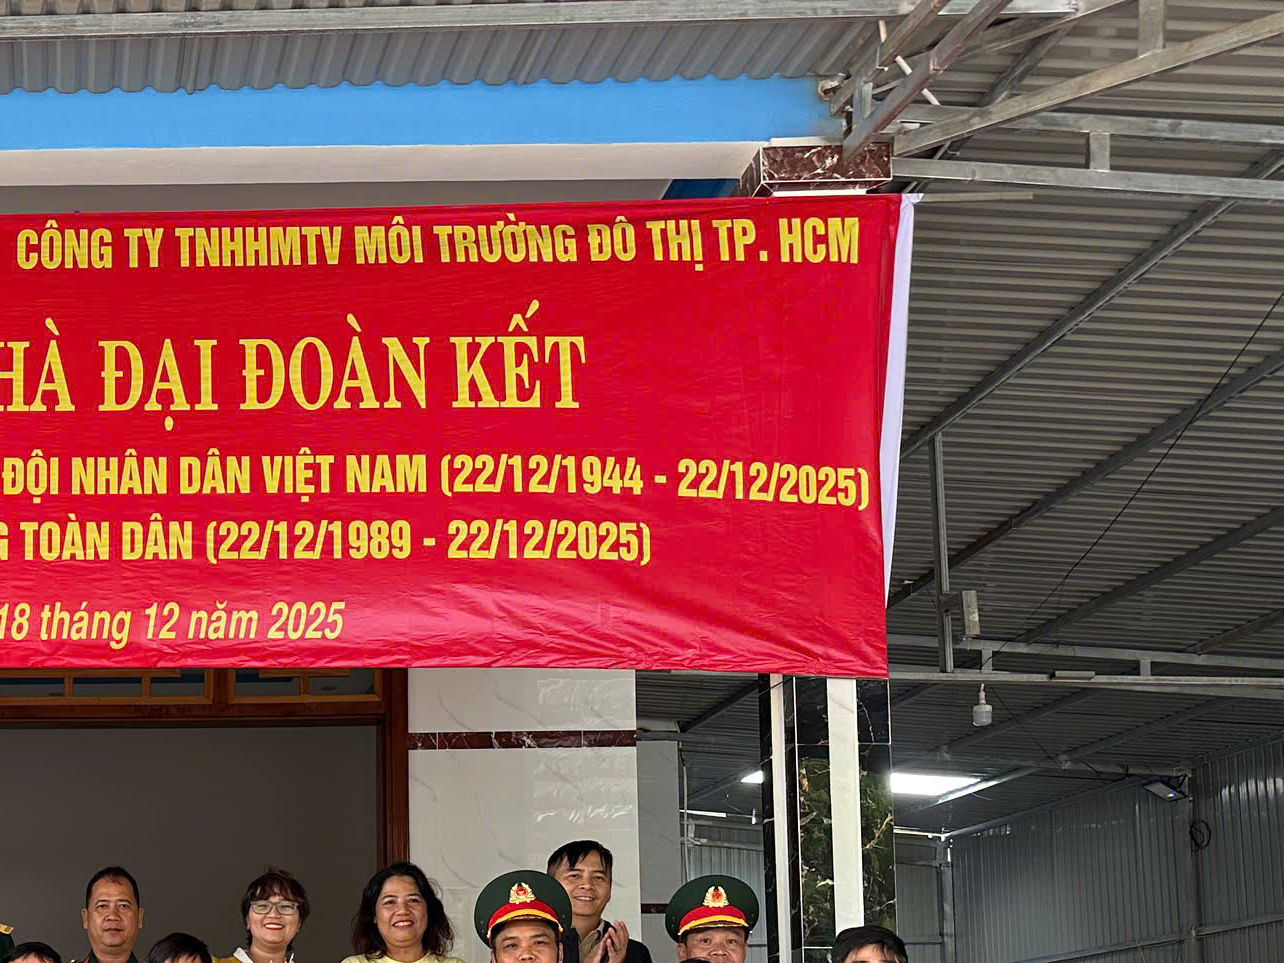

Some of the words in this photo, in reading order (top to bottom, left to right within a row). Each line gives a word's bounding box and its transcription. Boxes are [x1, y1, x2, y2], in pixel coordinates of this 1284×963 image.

[16, 219, 113, 270] CÔNG
[123, 227, 165, 268] TY
[174, 226, 342, 268] TNHHMTV
[355, 215, 424, 265] MÔI
[432, 212, 578, 263] TRƯỜNG
[587, 215, 637, 262] ĐÔ
[645, 219, 705, 272] THỊ
[712, 218, 768, 262] TP.
[779, 216, 860, 264] HCM
[98, 338, 219, 431] ĐẠI
[238, 313, 430, 411] ĐOÀN
[449, 299, 586, 409] KẾT
[1, 448, 59, 504] ĐỘI
[71, 448, 168, 495] NHÂN
[179, 448, 251, 495] DÂN
[261, 447, 335, 503] VIỆT
[345, 454, 427, 493] NAM
[440, 453, 644, 497] (22/12/1944
[677, 458, 869, 511] 22/12/2025)
[19, 513, 110, 561] TOÀN
[121, 514, 193, 561] DÂN
[206, 519, 411, 565] (22/12/1989
[447, 519, 651, 566] 22/12/2025)
[39, 601, 132, 650] tháng
[144, 601, 180, 640] 12
[188, 602, 259, 641] năm
[267, 601, 346, 641] 2025
